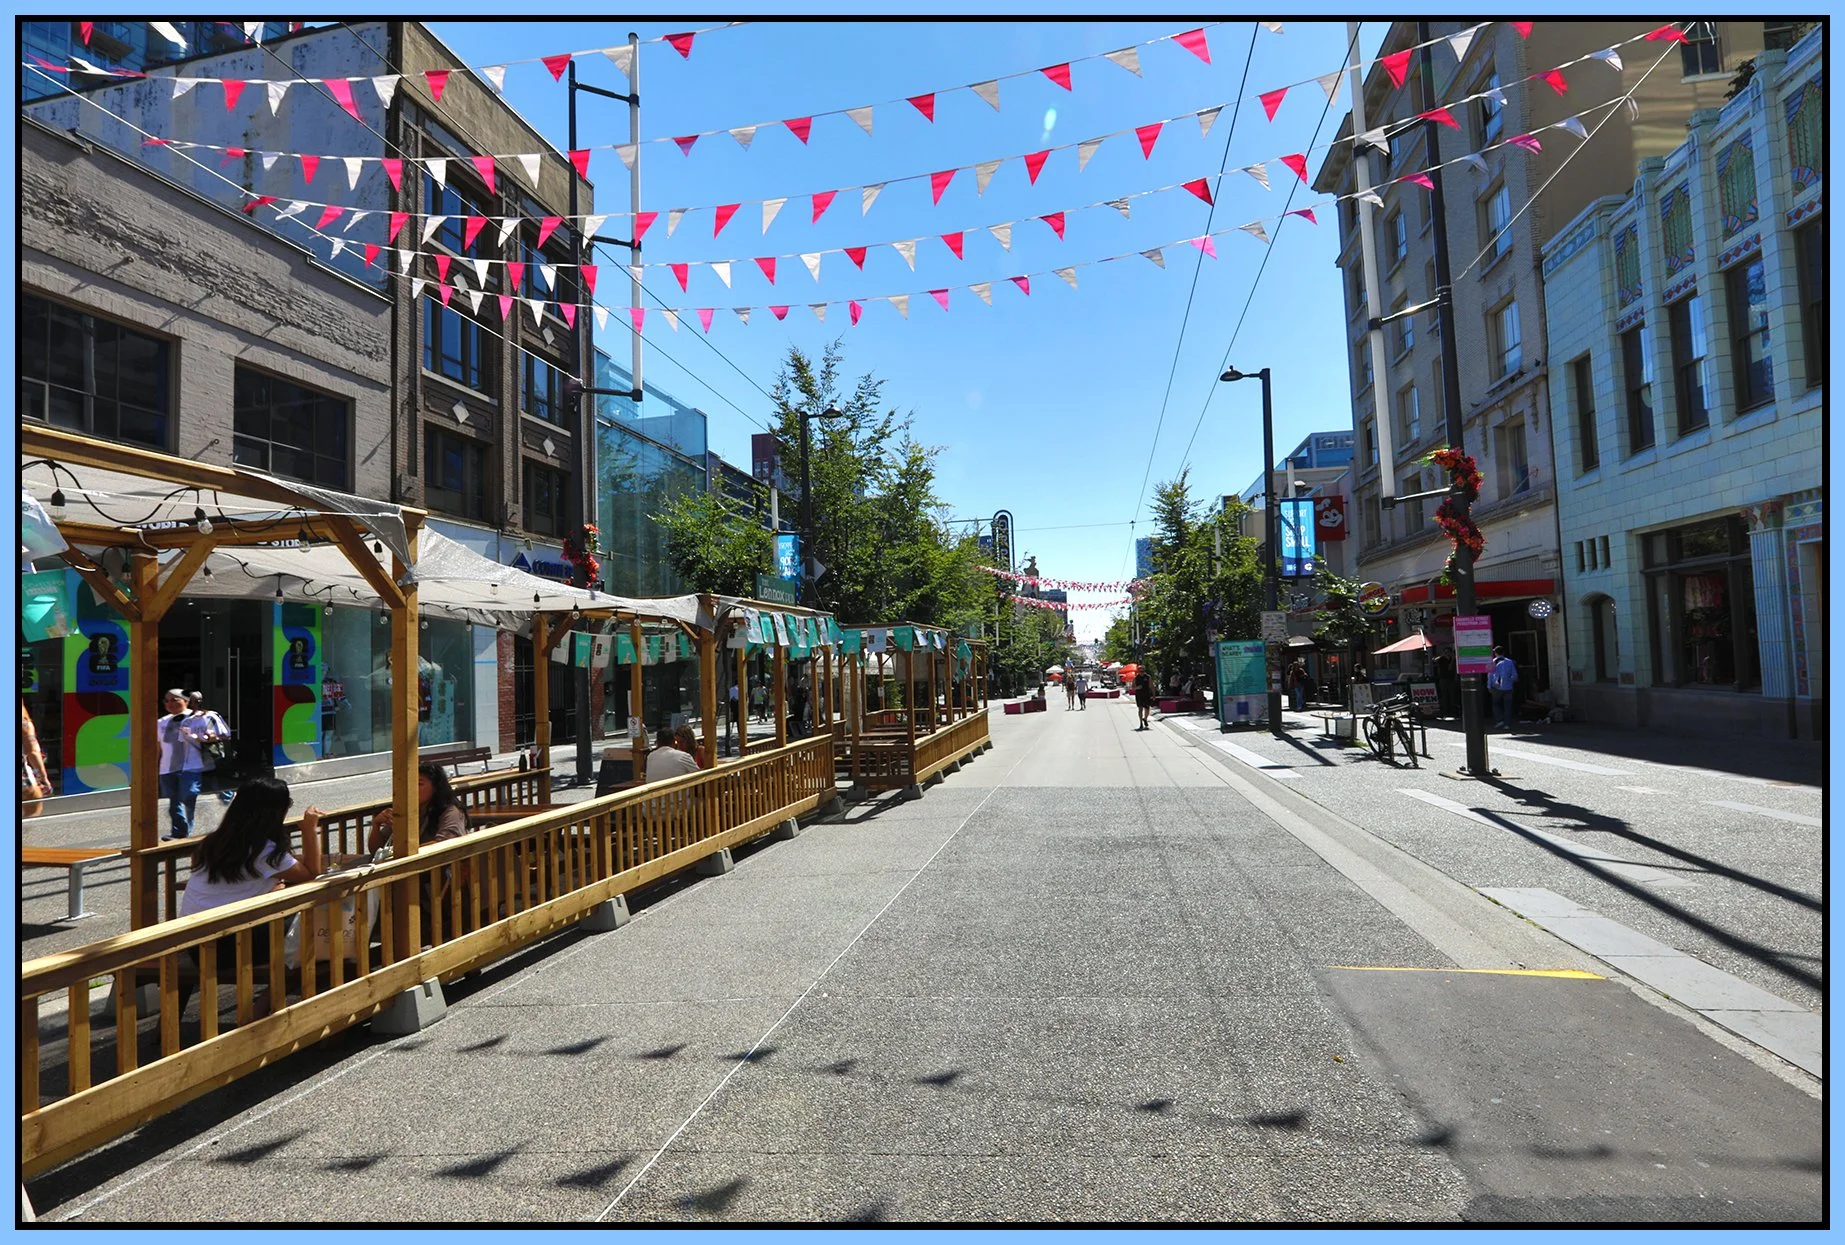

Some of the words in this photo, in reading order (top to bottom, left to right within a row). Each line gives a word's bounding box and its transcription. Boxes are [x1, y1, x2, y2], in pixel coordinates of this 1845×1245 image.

[759, 585, 785, 602] Lennox
[1359, 587, 1385, 603] BURGER
[1412, 688, 1435, 696] NOW
